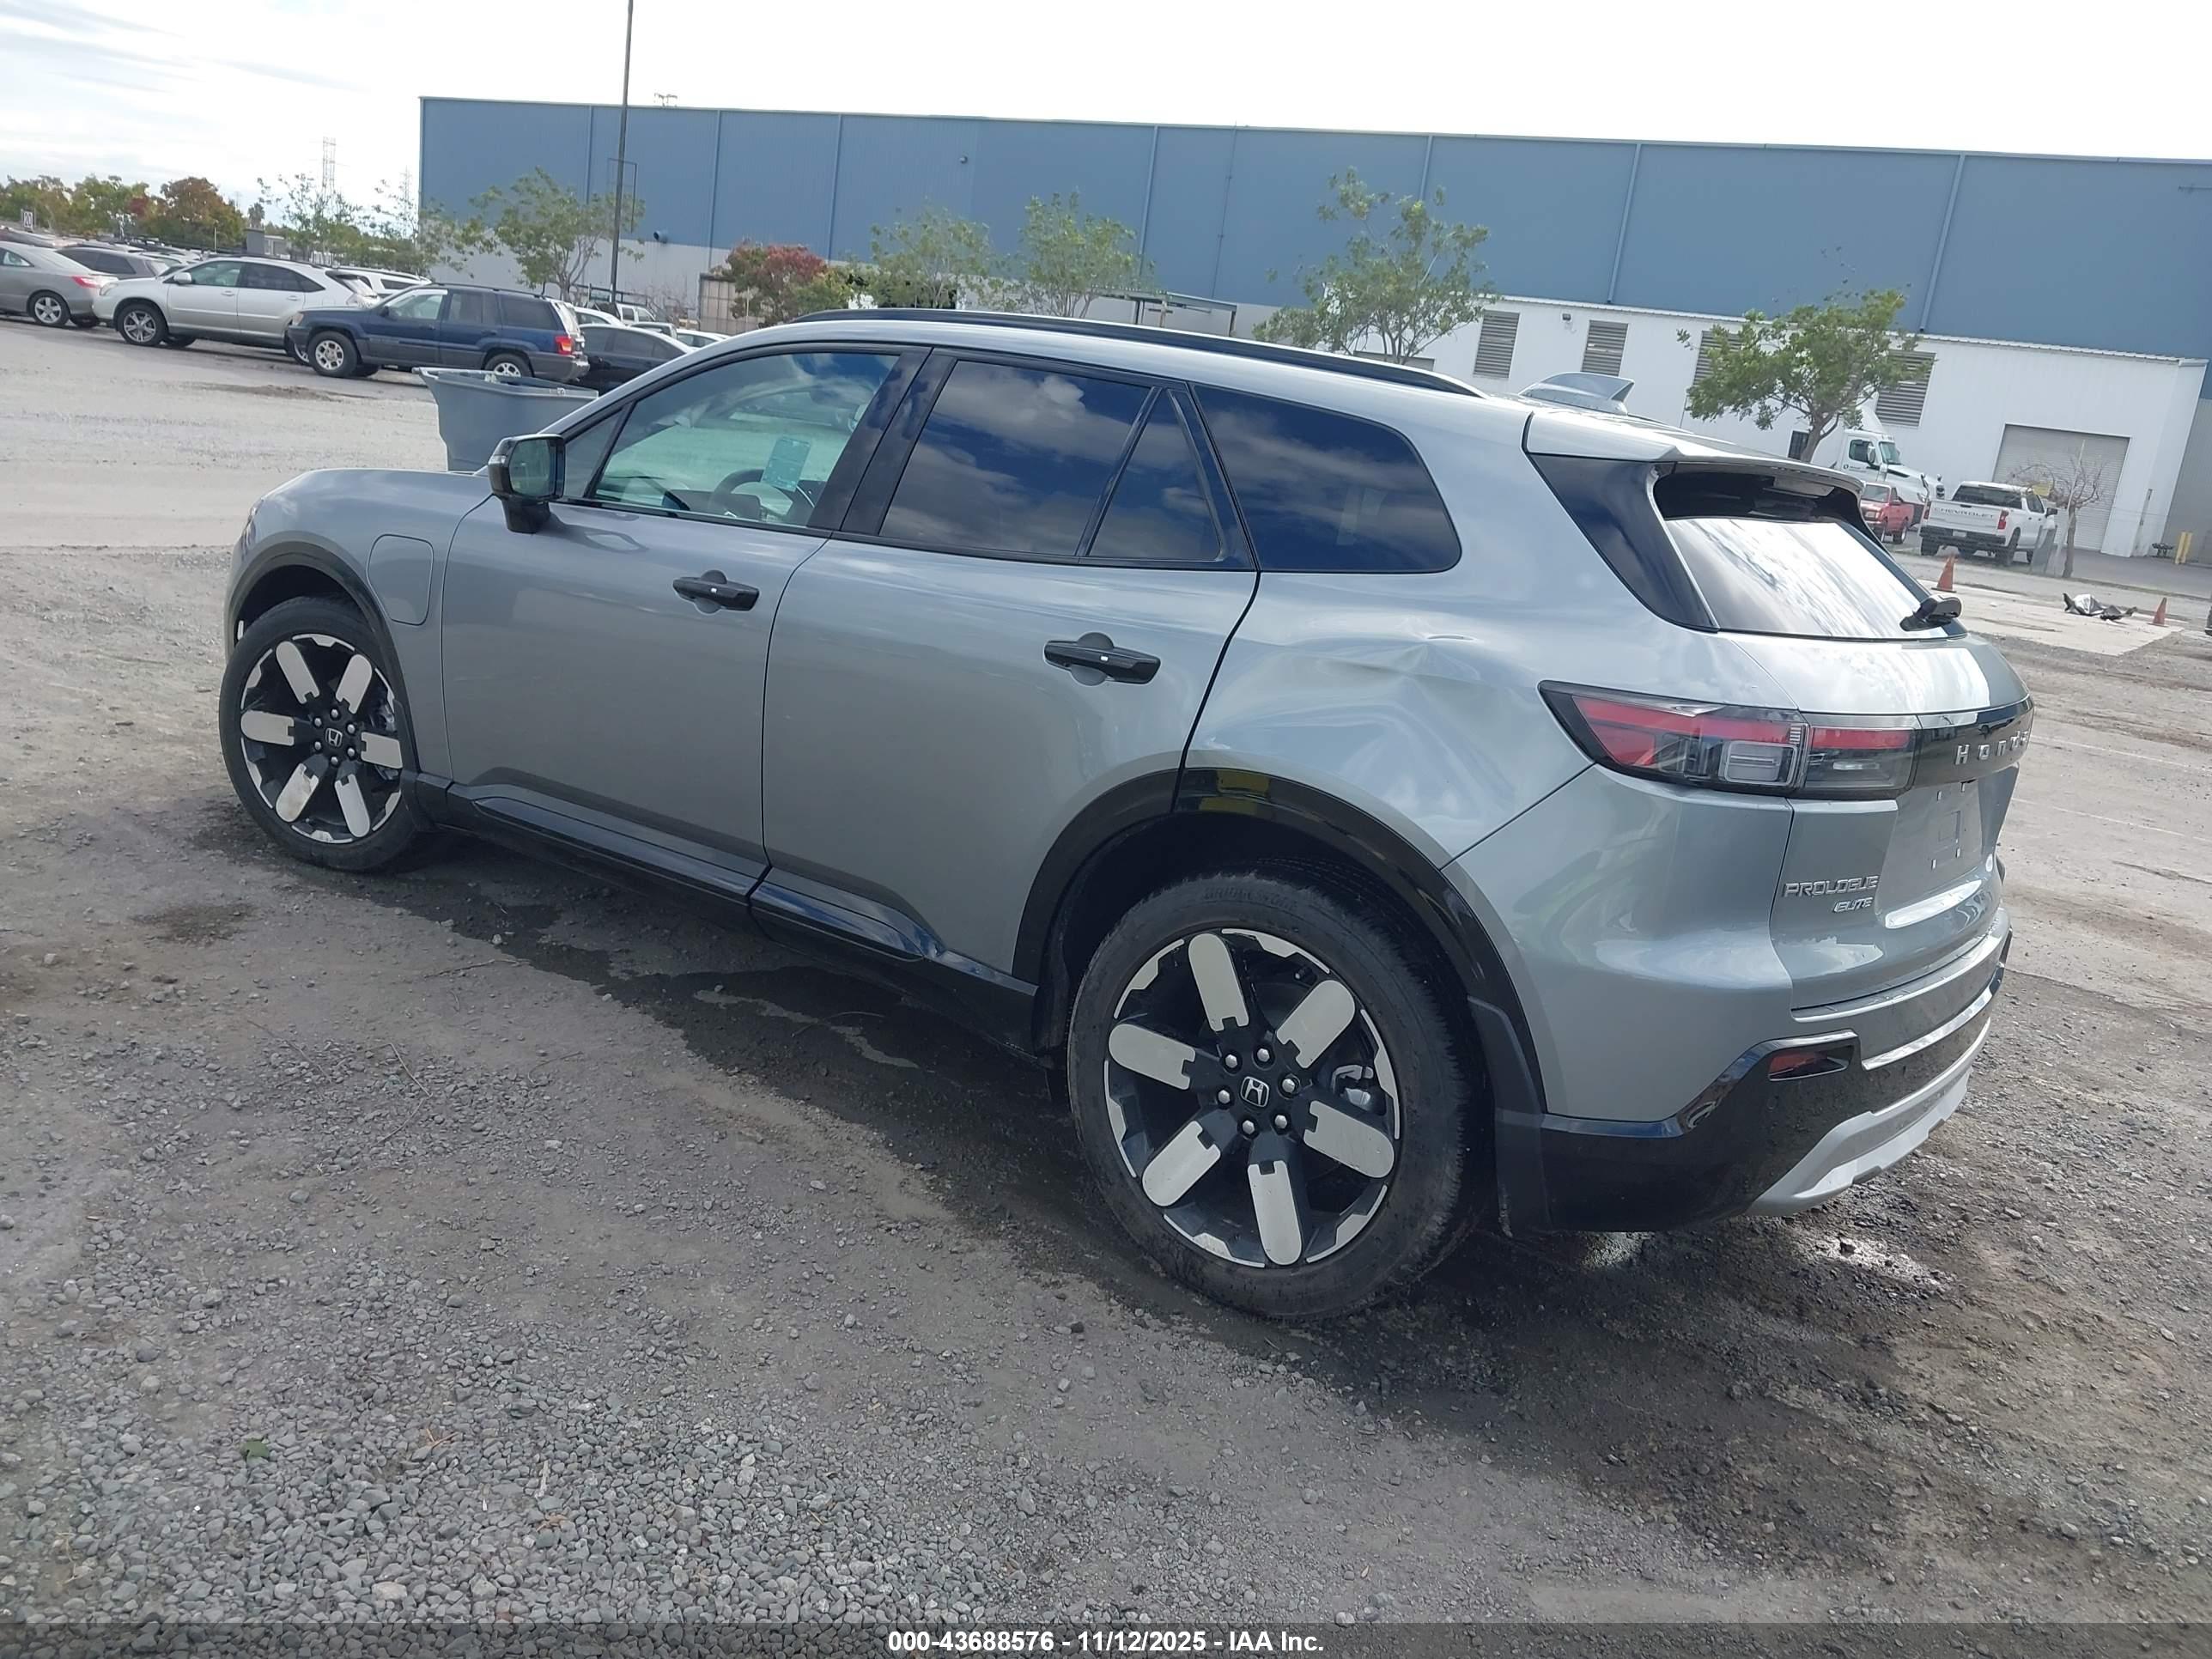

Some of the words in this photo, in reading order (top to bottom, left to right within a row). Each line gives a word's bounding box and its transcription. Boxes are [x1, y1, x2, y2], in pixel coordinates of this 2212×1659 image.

[1934, 507, 1994, 520] CHEVROLET
[1784, 875, 1879, 896] PROLOGUE
[1832, 896, 1873, 912] ELITE
